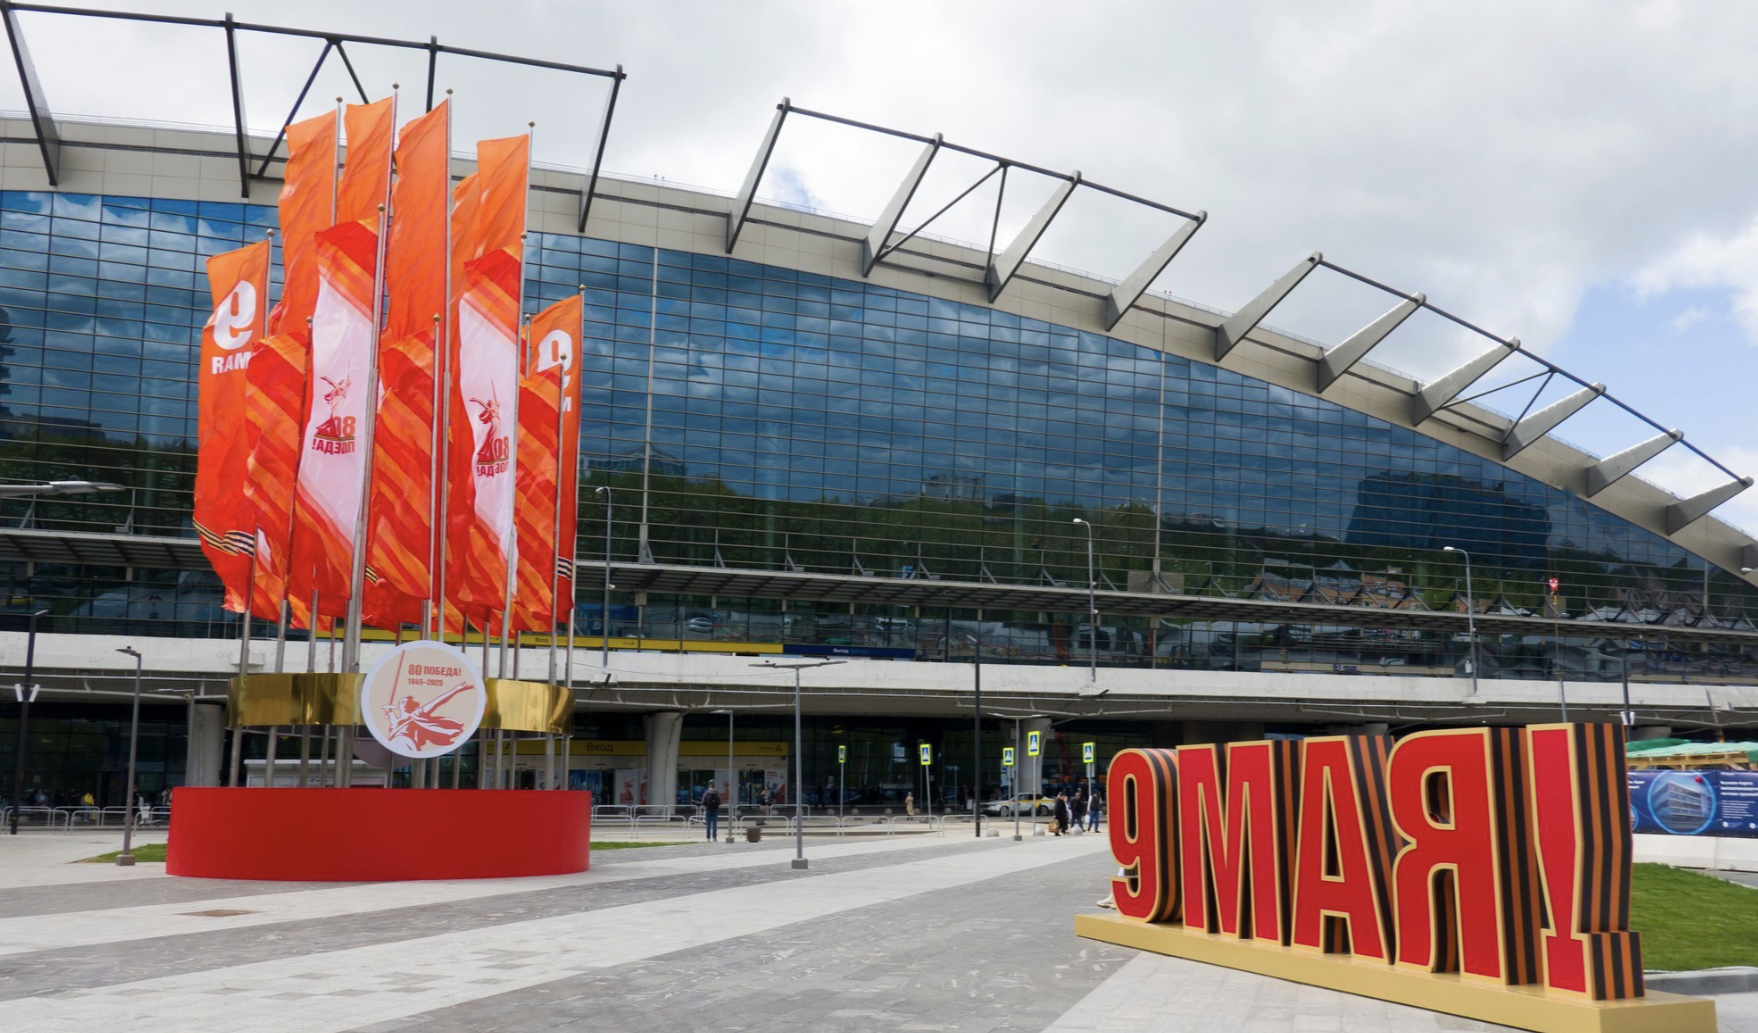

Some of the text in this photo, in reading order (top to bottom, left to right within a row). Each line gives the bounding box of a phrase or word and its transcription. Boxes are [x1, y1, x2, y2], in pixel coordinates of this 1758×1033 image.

[408, 664, 462, 678] 80 ПОБЕДА!
[587, 742, 613, 752] Вход
[1107, 722, 1595, 1000] 9 МАЯ!
